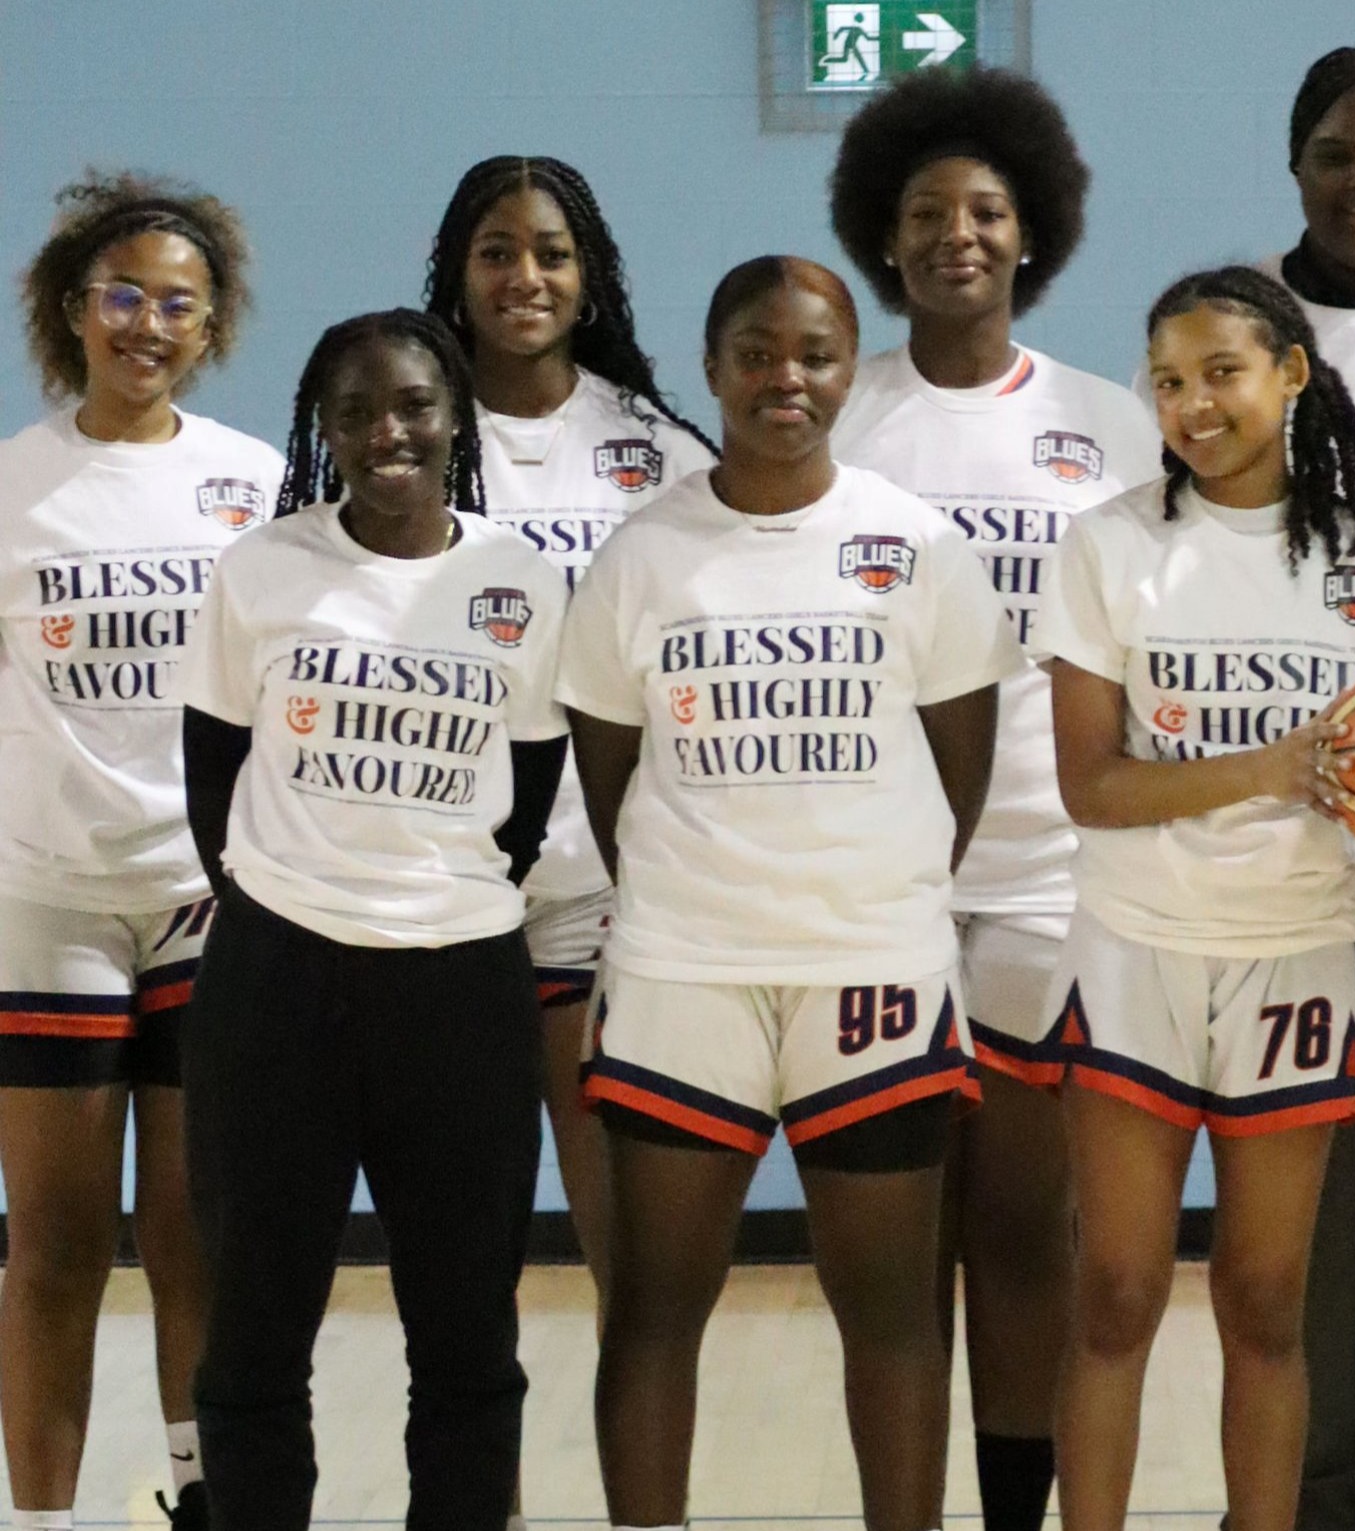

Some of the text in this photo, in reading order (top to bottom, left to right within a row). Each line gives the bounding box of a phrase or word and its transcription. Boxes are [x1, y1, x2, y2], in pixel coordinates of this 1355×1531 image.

[596, 446, 661, 478] BLUES
[1035, 435, 1102, 475] BLUES
[199, 486, 264, 515] BLUES
[841, 543, 915, 577] BLUES
[36, 558, 214, 606] BLESSE
[662, 625, 884, 673] BLESSED
[288, 647, 508, 707] BLESSED
[710, 679, 882, 721] HIGHLY
[674, 733, 878, 776] FAVOURED
[838, 985, 917, 1056] 95
[1257, 996, 1332, 1080] 76
